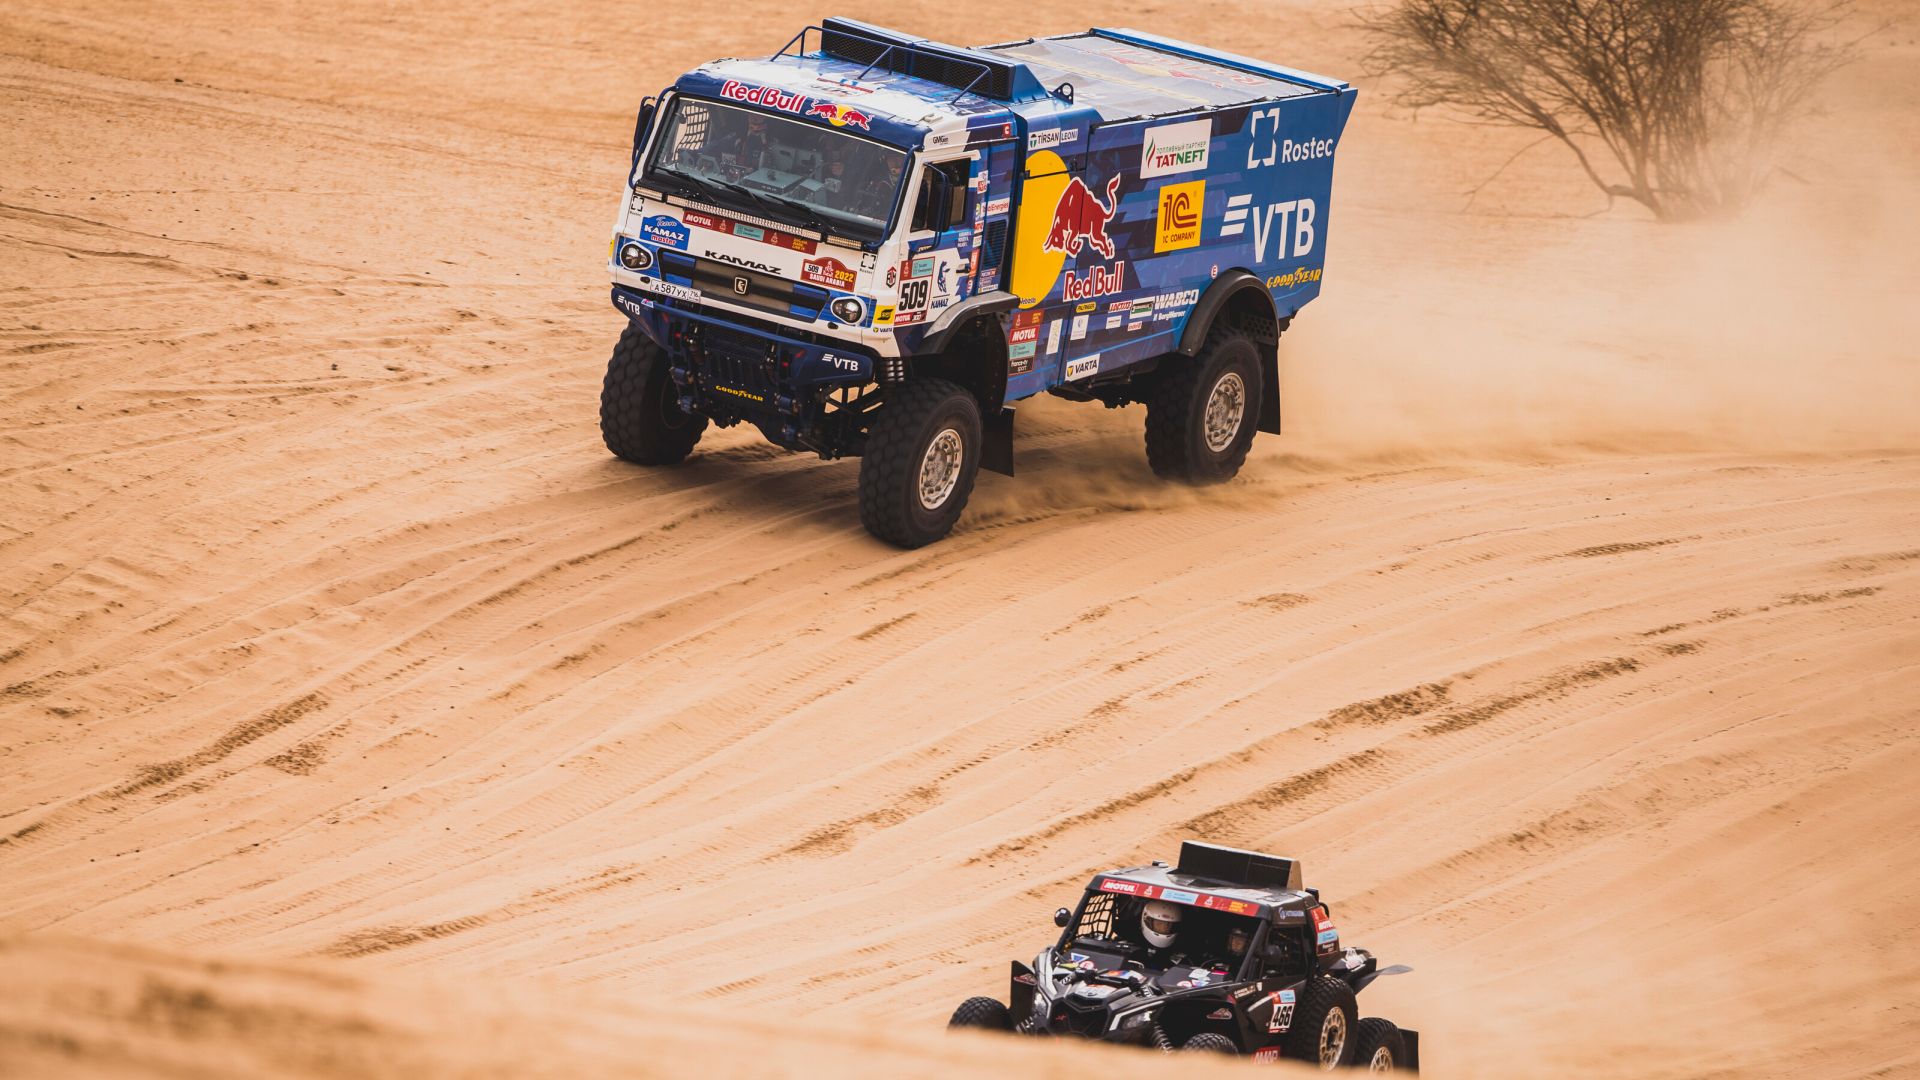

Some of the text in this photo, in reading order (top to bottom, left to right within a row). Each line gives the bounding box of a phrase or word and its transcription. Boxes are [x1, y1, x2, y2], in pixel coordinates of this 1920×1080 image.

[720, 79, 768, 105] Red
[762, 86, 807, 113] Bull
[1061, 131, 1078, 141] LEONI
[1282, 137, 1334, 163] Rostec
[1155, 149, 1206, 168] TATNEFT
[685, 214, 712, 226] MOTUL
[644, 225, 685, 241] KAMAZ
[1170, 231, 1195, 243] COMPANY
[1253, 198, 1316, 263] VTB
[651, 235, 677, 246] master
[704, 250, 782, 275] KAMAZ
[809, 273, 826, 283] SAUDI
[825, 277, 845, 288] ARABIA
[834, 270, 854, 283] 2022
[1063, 260, 1125, 303] Red Bull
[1266, 267, 1322, 289] GOODYEAR
[898, 280, 929, 311] 509
[1154, 289, 1200, 310] WABCO
[623, 299, 640, 315] VTB
[930, 298, 949, 310] KAMAZ
[1109, 301, 1131, 311] LOCTITE
[895, 314, 912, 323] MOTUL
[1012, 328, 1036, 342] MOTUL
[833, 357, 859, 371] VTB
[1075, 359, 1097, 374] VARTA
[715, 385, 764, 402] GOODYEAR
[1104, 882, 1135, 892] MOTUL
[1273, 1005, 1292, 1027] 466
